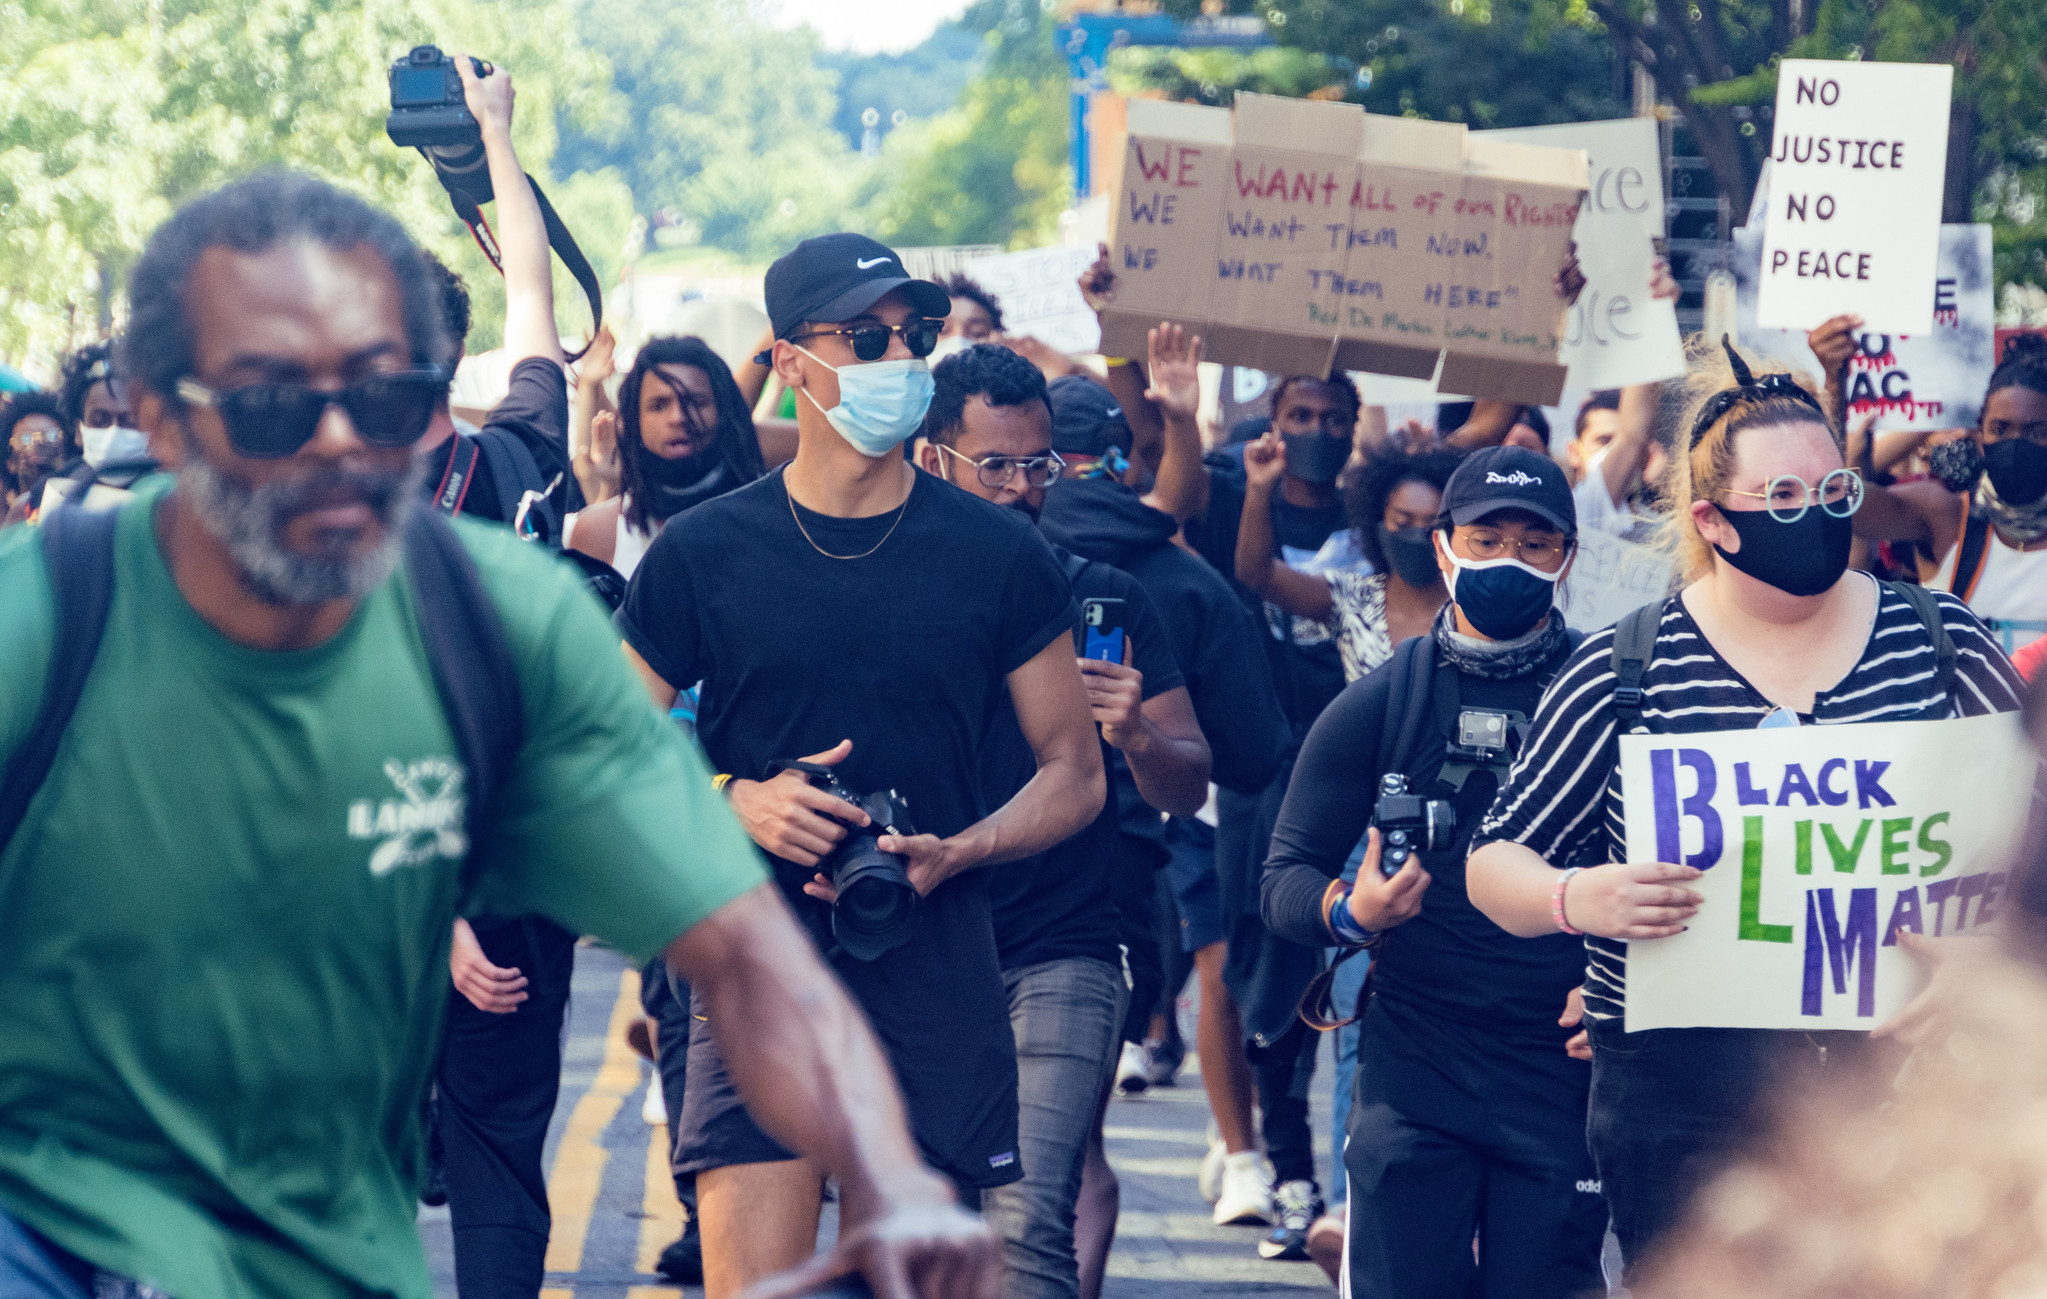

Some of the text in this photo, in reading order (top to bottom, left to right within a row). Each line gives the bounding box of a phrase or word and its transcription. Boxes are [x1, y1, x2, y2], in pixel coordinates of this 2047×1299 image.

[1796, 75, 1840, 106] NO
[1775, 136, 1905, 170] JUSTICE
[1349, 178, 1398, 213] ALL
[1786, 193, 1836, 223] NO
[1129, 189, 1179, 226] WE
[1325, 222, 1399, 251] THEM
[1124, 244, 1159, 272] WE
[1771, 249, 1873, 281] PEACE
[441, 472, 463, 508] Canon
[1649, 747, 1898, 872] BLACK
[1737, 811, 1953, 943] LIVES
[1800, 870, 2012, 1018] MATTE
